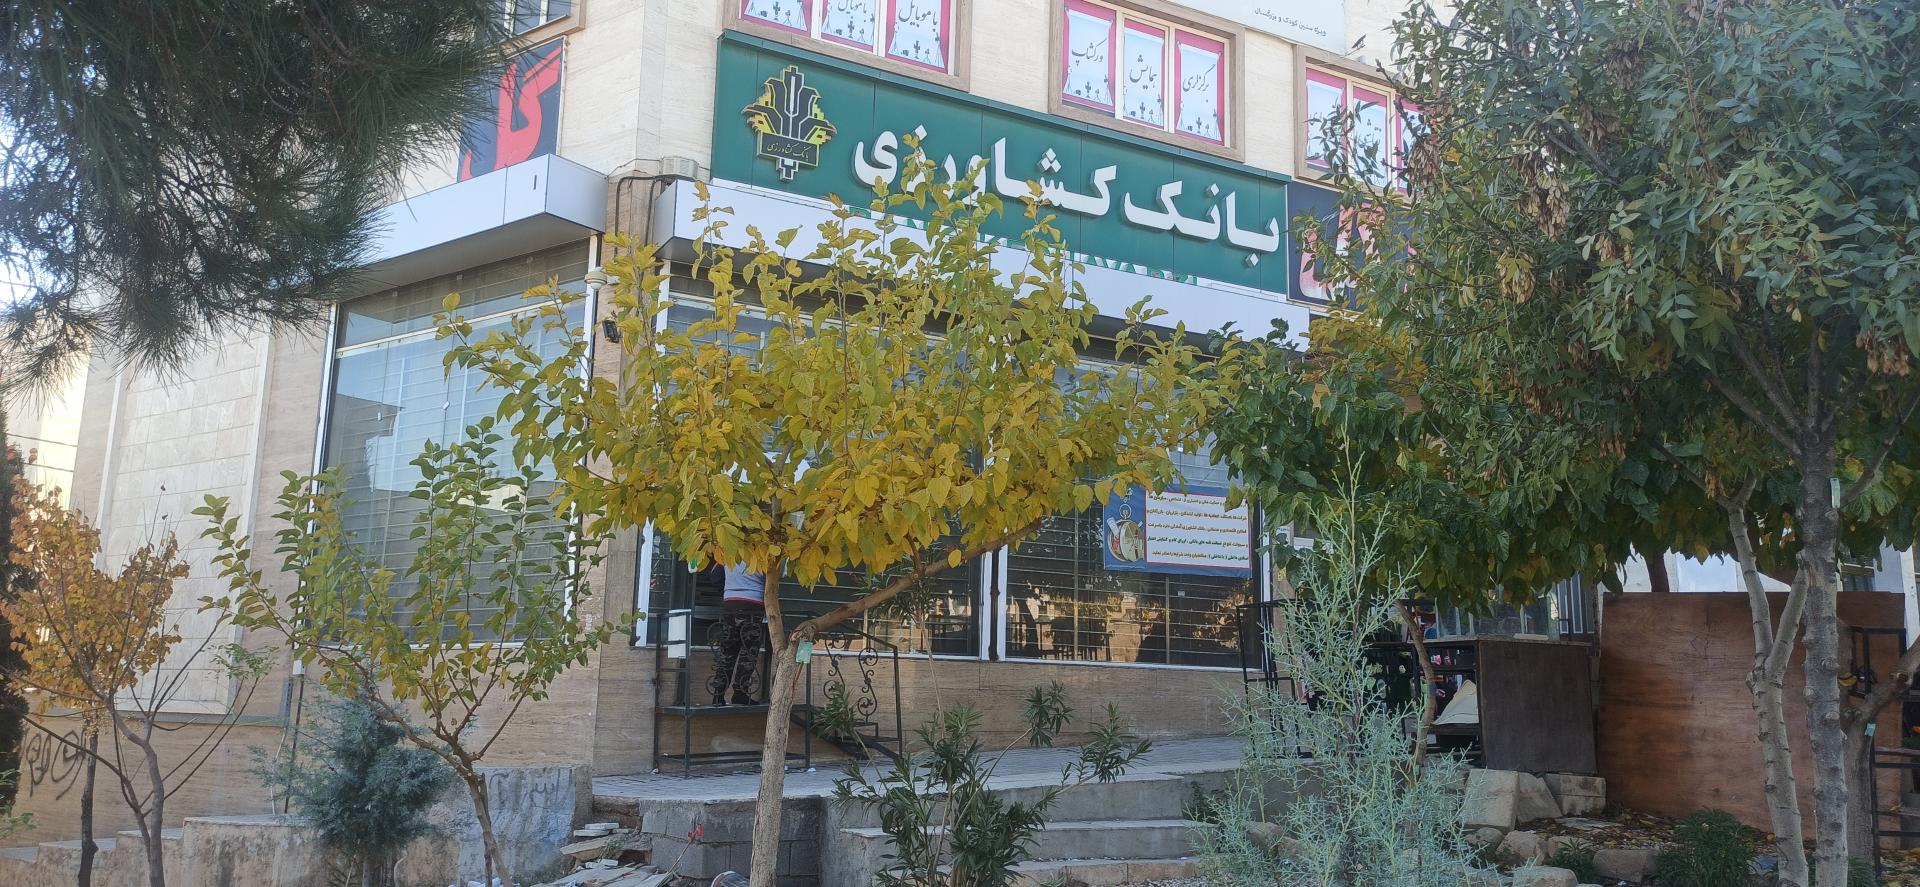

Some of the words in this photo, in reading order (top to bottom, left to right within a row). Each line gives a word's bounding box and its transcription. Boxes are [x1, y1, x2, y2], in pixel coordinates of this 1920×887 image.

[1283, 17, 1298, 26] کودک
[1299, 20, 1313, 31] سنین
[1314, 26, 1326, 37] ویژه
[1071, 37, 1107, 66] ورکشاپ
[1129, 53, 1157, 90] همایش
[766, 142, 799, 154] کشاورزی
[792, 145, 812, 161] بانک
[853, 124, 1118, 216] کشاورزی
[1122, 180, 1280, 268] بانک
